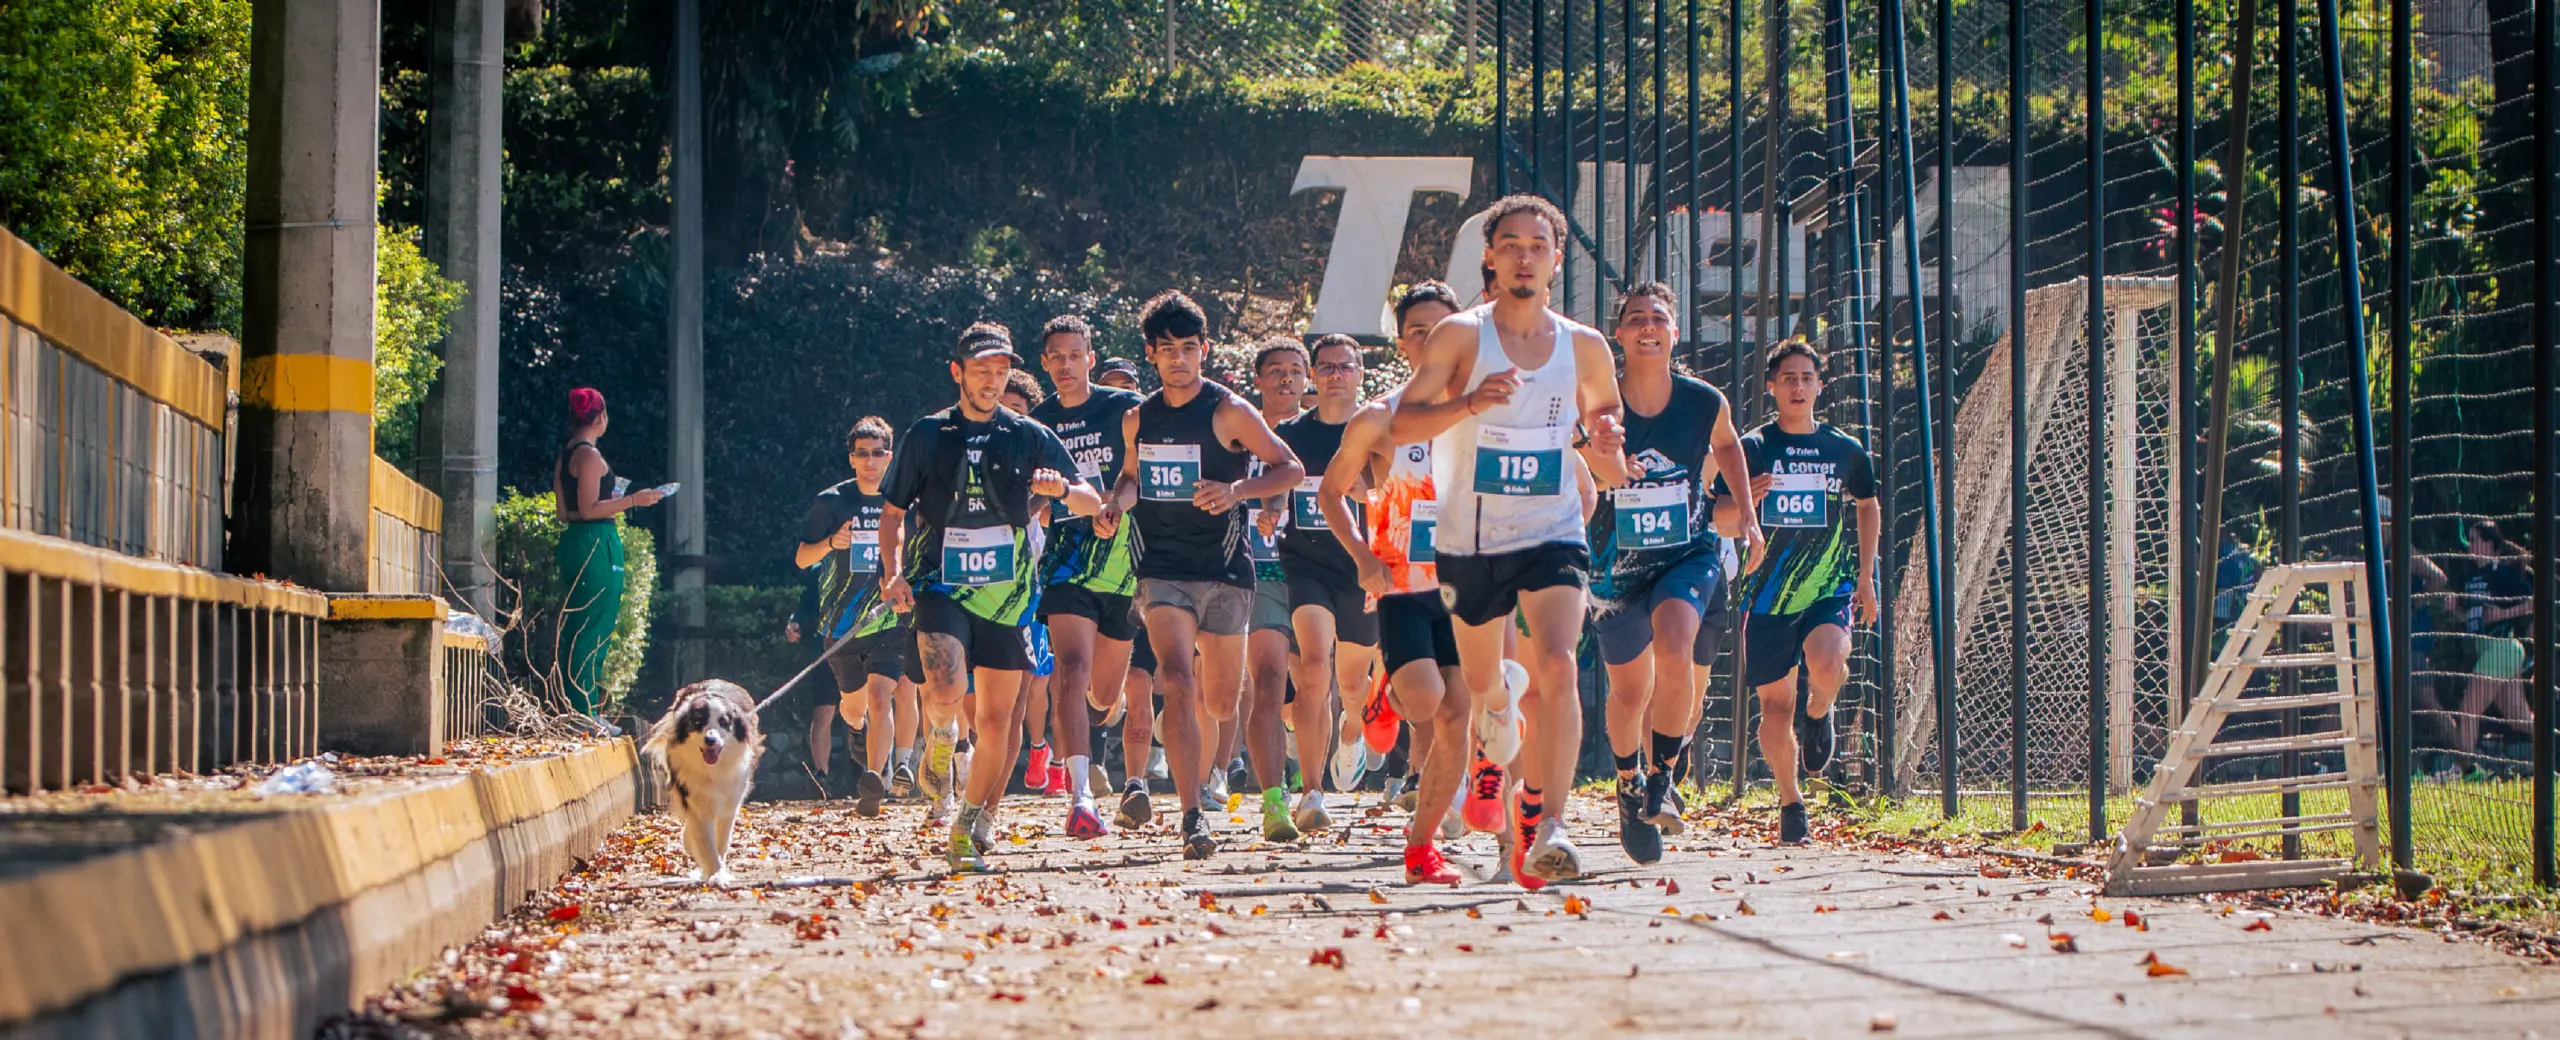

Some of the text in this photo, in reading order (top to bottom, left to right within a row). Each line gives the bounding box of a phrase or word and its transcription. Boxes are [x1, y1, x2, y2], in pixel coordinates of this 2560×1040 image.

[1795, 447, 1820, 456] TdeA
[1499, 455, 1539, 480] 119
[1772, 459, 1836, 474] A correr
[1150, 466, 1183, 486] 316
[968, 498, 986, 512] 5K
[1776, 495, 1815, 513] 066
[852, 515, 861, 529] A
[1631, 510, 1672, 533] 194
[958, 550, 997, 571] 106
